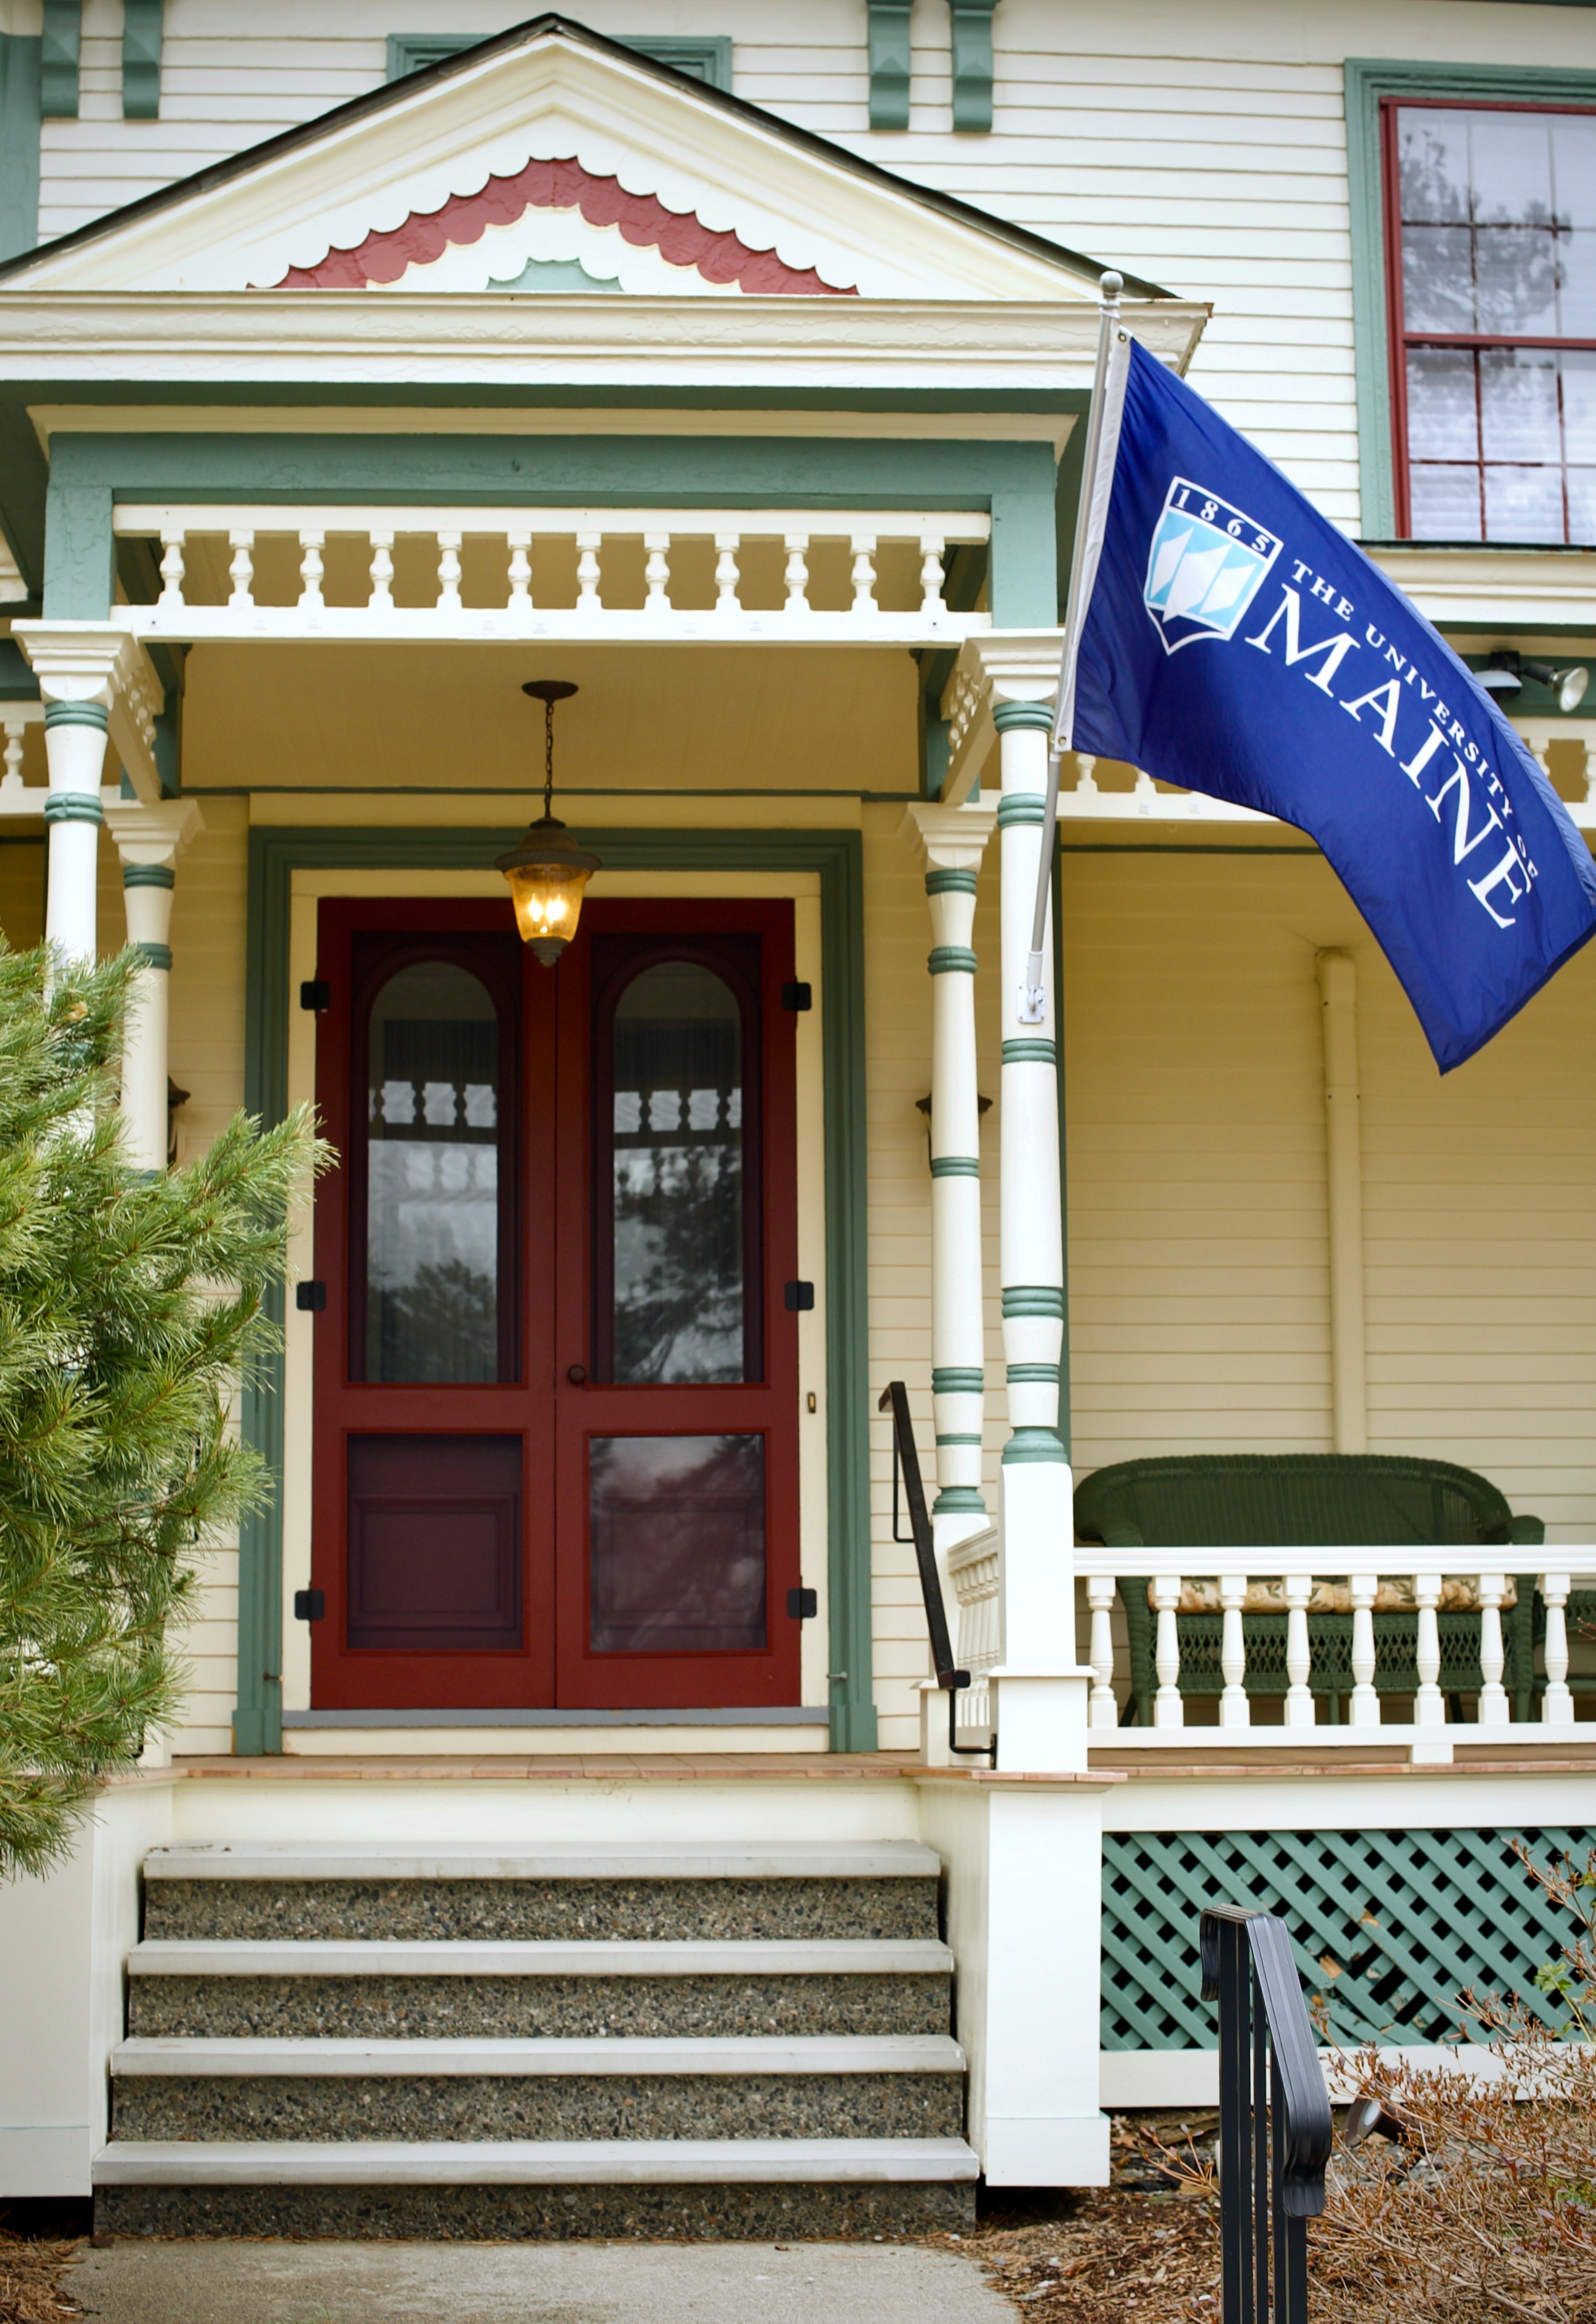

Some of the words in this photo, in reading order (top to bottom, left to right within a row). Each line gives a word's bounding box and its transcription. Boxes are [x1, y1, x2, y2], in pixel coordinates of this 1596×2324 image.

[1174, 488, 1270, 553] 1865
[1244, 582, 1532, 929] MAINE
[1291, 559, 1354, 622] THE
[1365, 623, 1513, 818] UNIVERSITY
